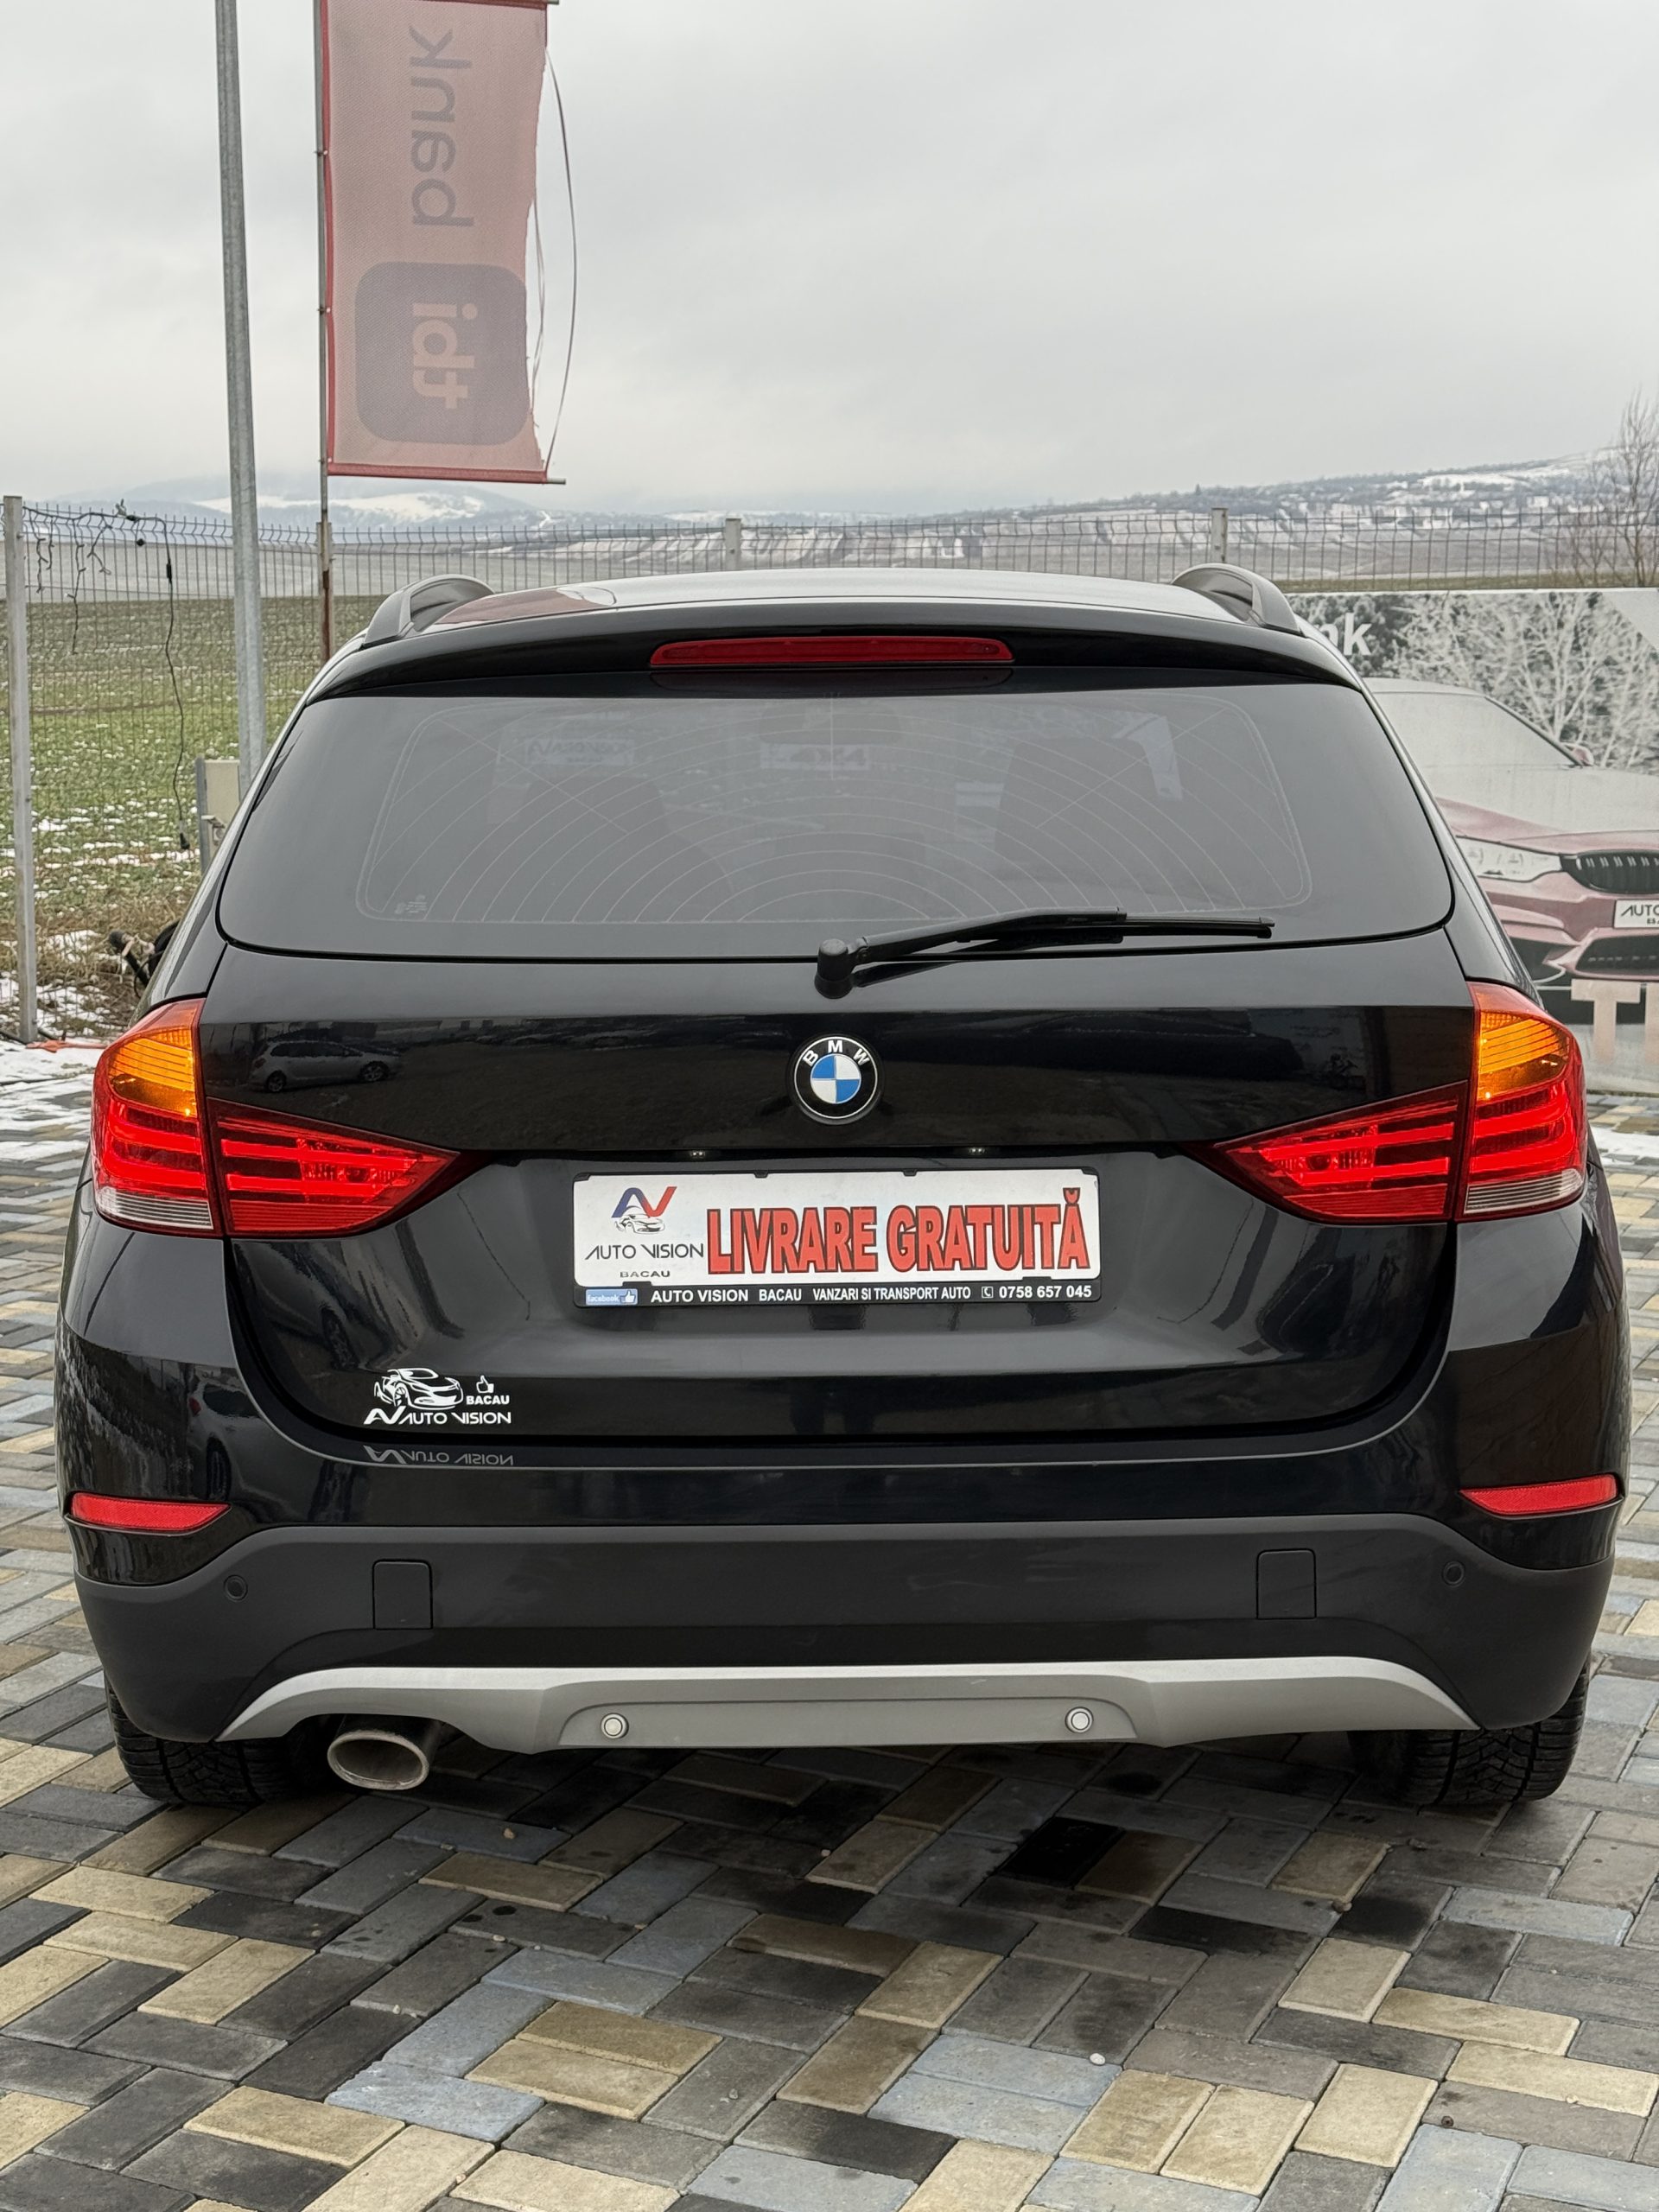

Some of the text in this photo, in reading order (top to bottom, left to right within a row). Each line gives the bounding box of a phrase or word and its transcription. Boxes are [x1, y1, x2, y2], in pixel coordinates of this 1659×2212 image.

[803, 1039, 870, 1067] BMW
[707, 1187, 1090, 1274] LIVRARE GRATUITĂ
[585, 1243, 704, 1260] AUTO VISION
[651, 1285, 1092, 1303] AUTO VISION BACAU VANZARI SI TRANSPORT AUTO 0758 657 045
[466, 1395, 510, 1405] BACAU
[398, 1412, 448, 1425] AUTO
[451, 1411, 512, 1425] VISION
